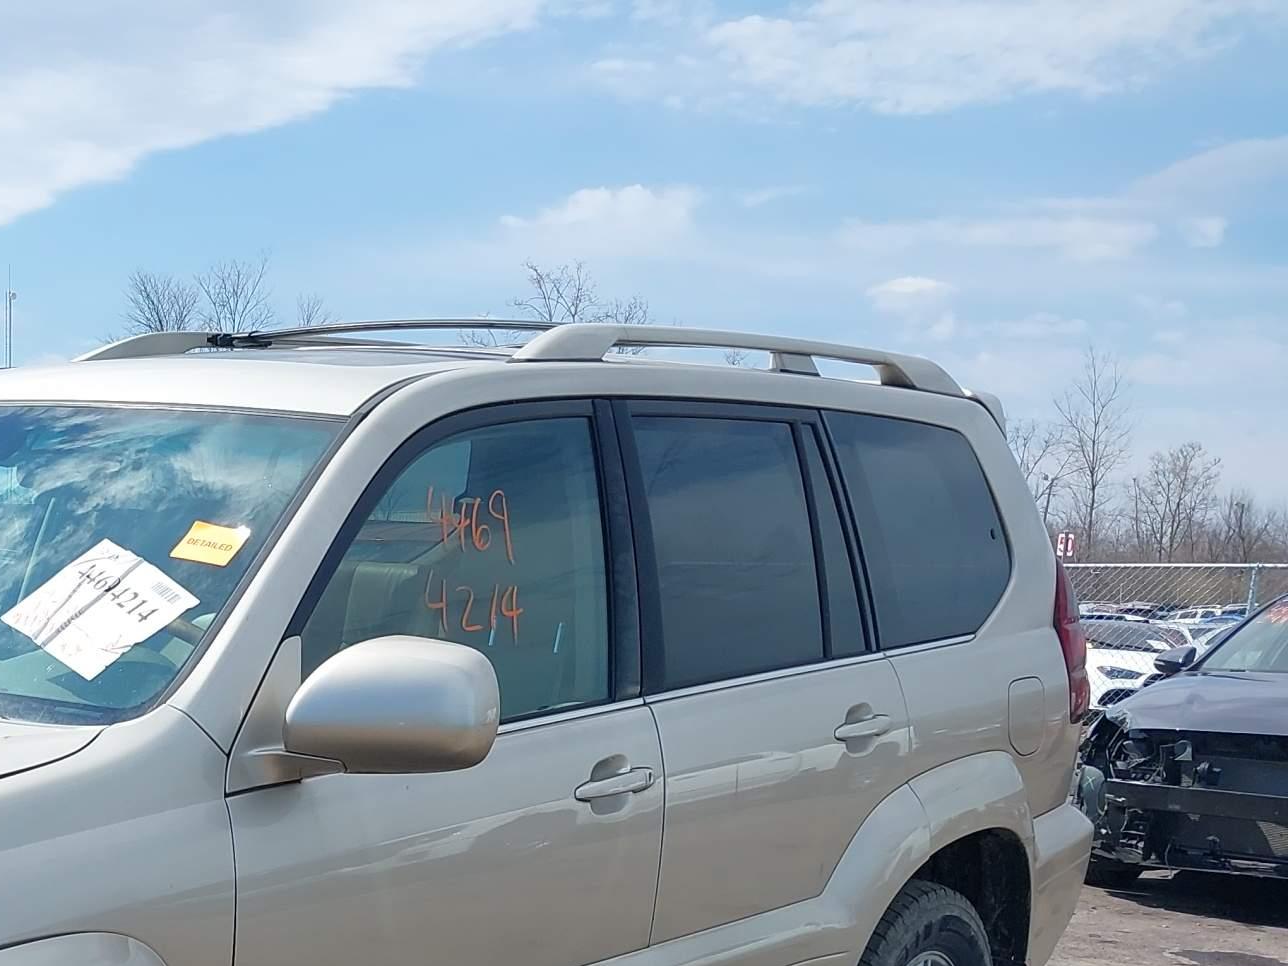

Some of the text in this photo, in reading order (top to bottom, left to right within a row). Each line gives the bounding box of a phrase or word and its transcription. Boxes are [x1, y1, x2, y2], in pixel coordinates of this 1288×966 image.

[186, 537, 233, 552] DETAILED
[427, 485, 515, 564] 4469
[425, 569, 524, 646] 4214
